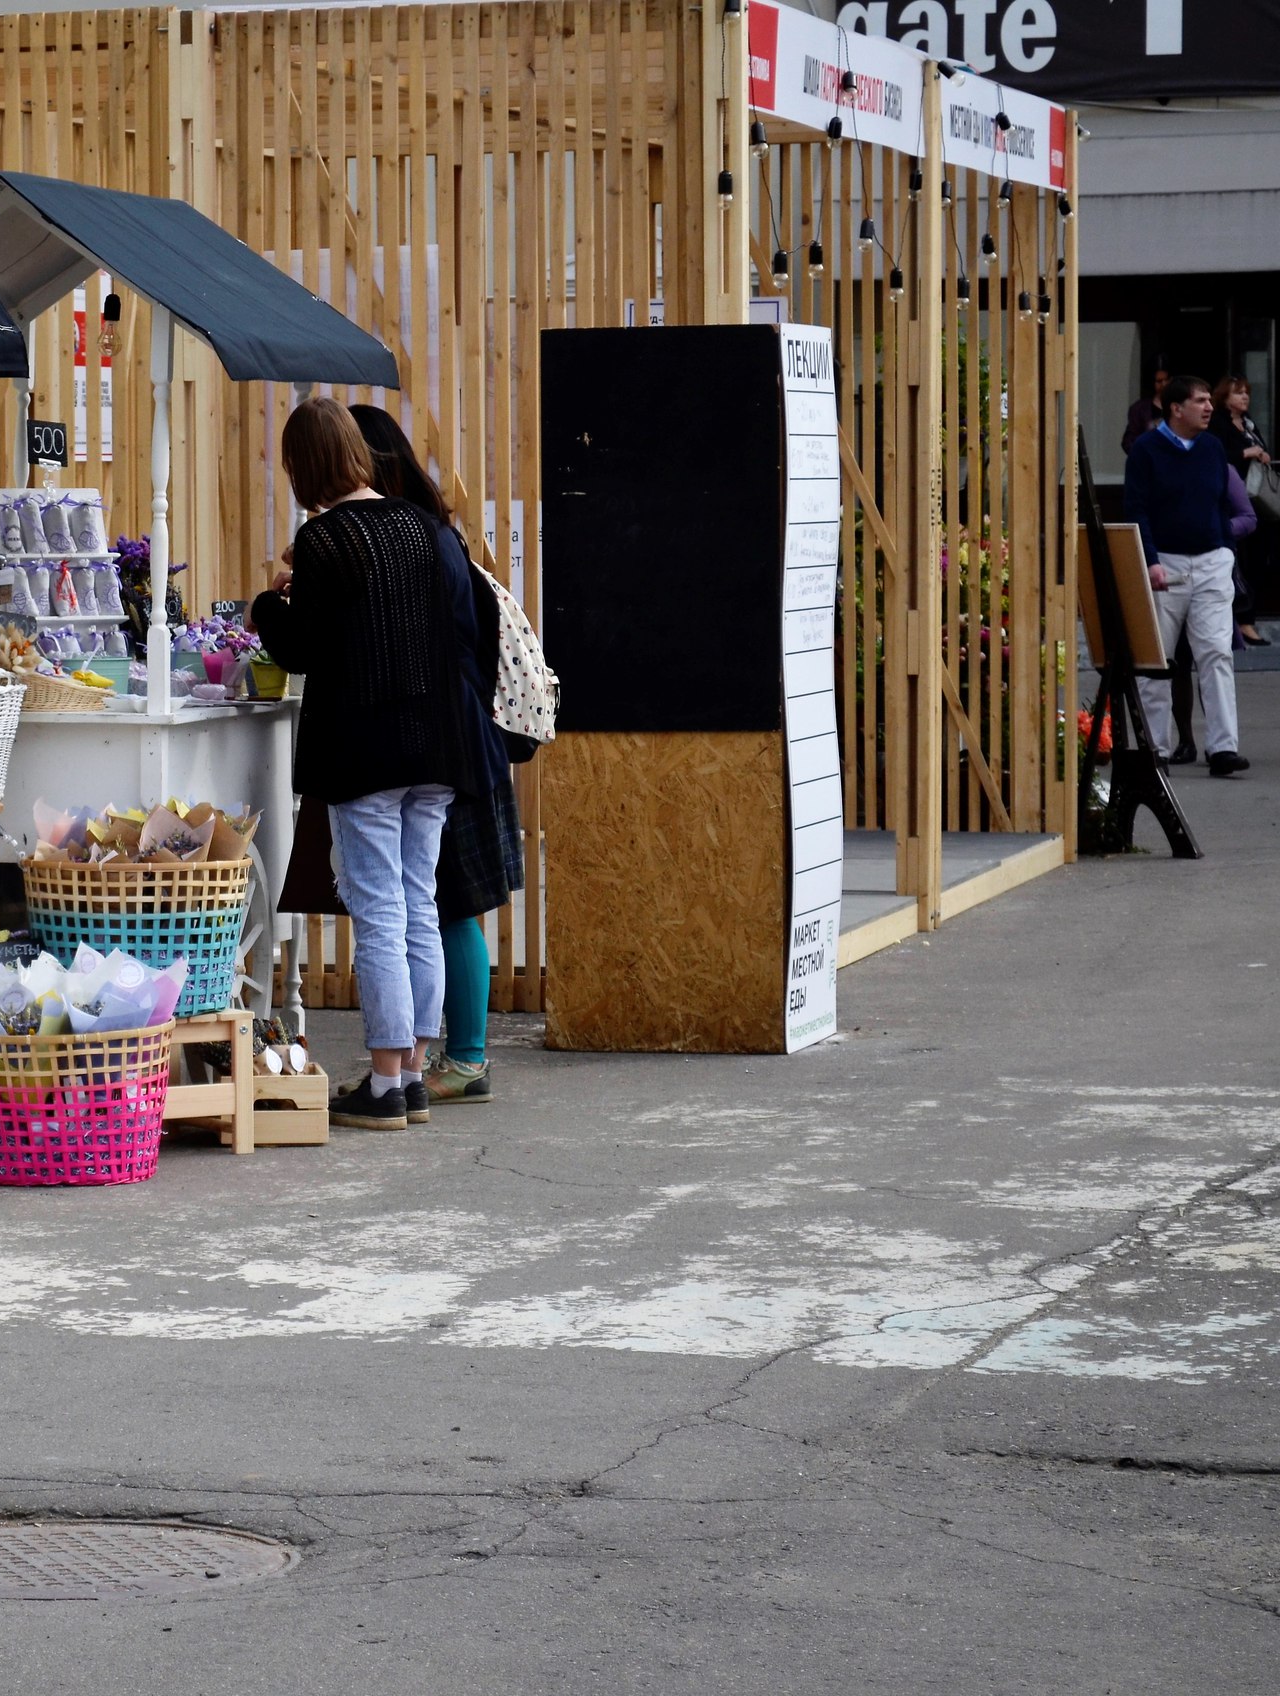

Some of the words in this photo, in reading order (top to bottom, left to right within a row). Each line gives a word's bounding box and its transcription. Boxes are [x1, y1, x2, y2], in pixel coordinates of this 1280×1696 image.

[787, 339, 831, 388] ЛЕКЦИИ
[32, 425, 65, 455] 500
[215, 600, 236, 613] 200
[793, 919, 821, 949] МАРКЕТ
[791, 943, 825, 981] МЕСТНОЙ
[789, 987, 807, 1016] ЕДЫ
